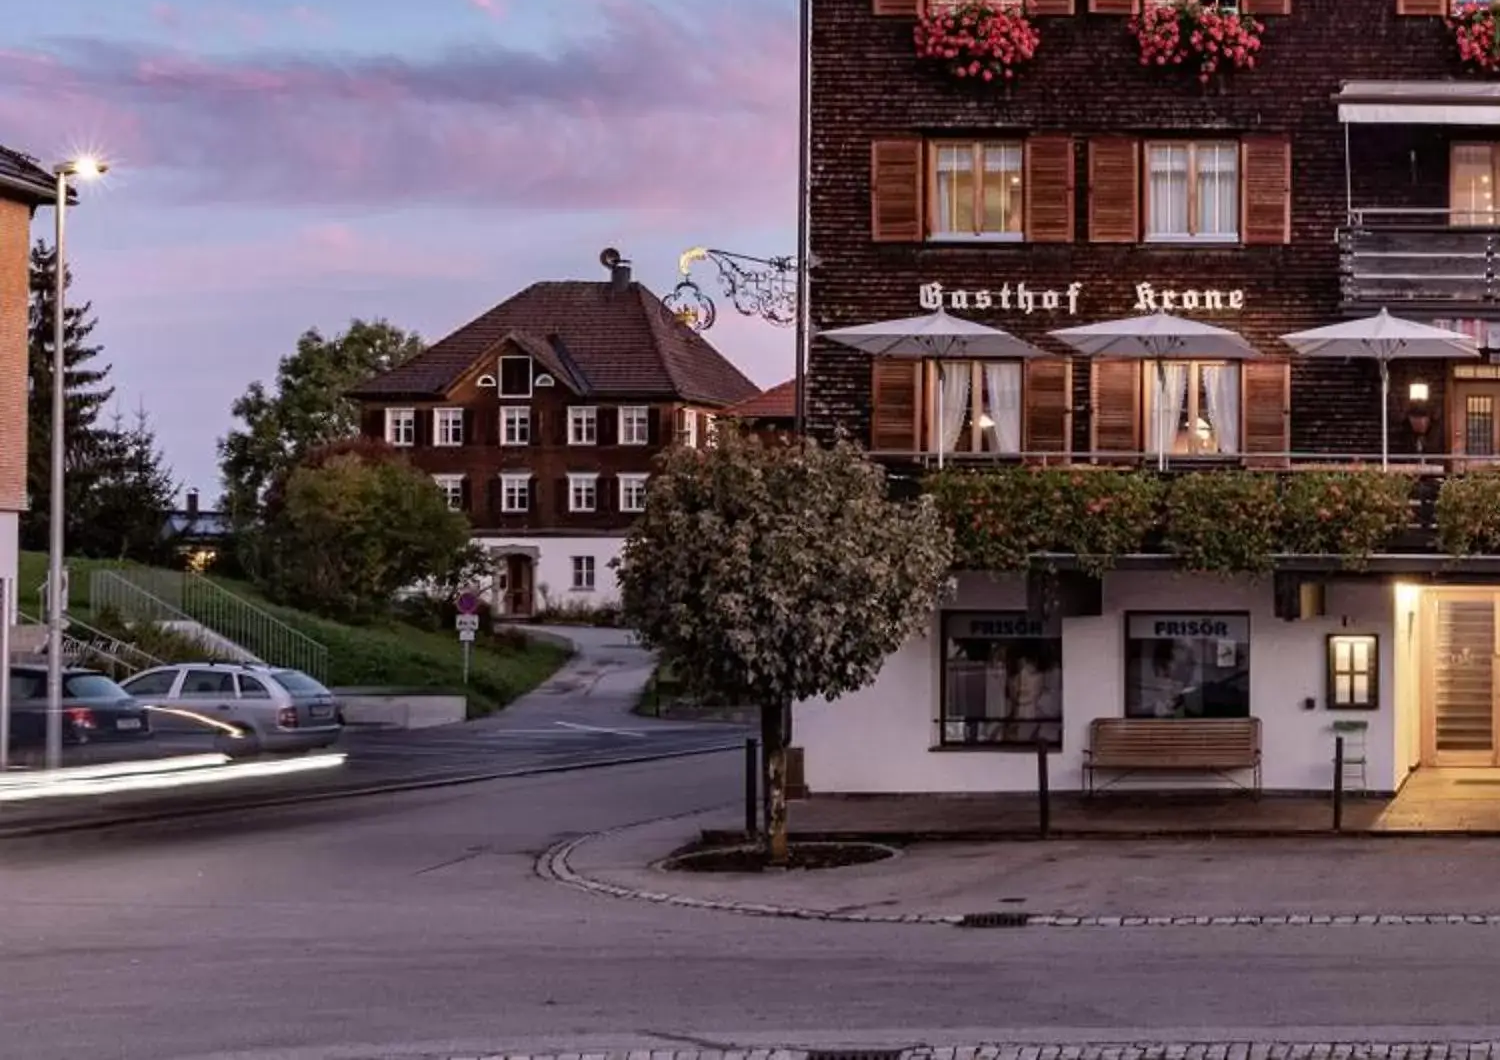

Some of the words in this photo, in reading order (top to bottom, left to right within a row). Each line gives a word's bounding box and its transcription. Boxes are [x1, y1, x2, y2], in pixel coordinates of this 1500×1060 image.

[918, 281, 1082, 315] Gasthof
[1134, 281, 1244, 310] Krone
[1154, 618, 1227, 636] FRISÖR
